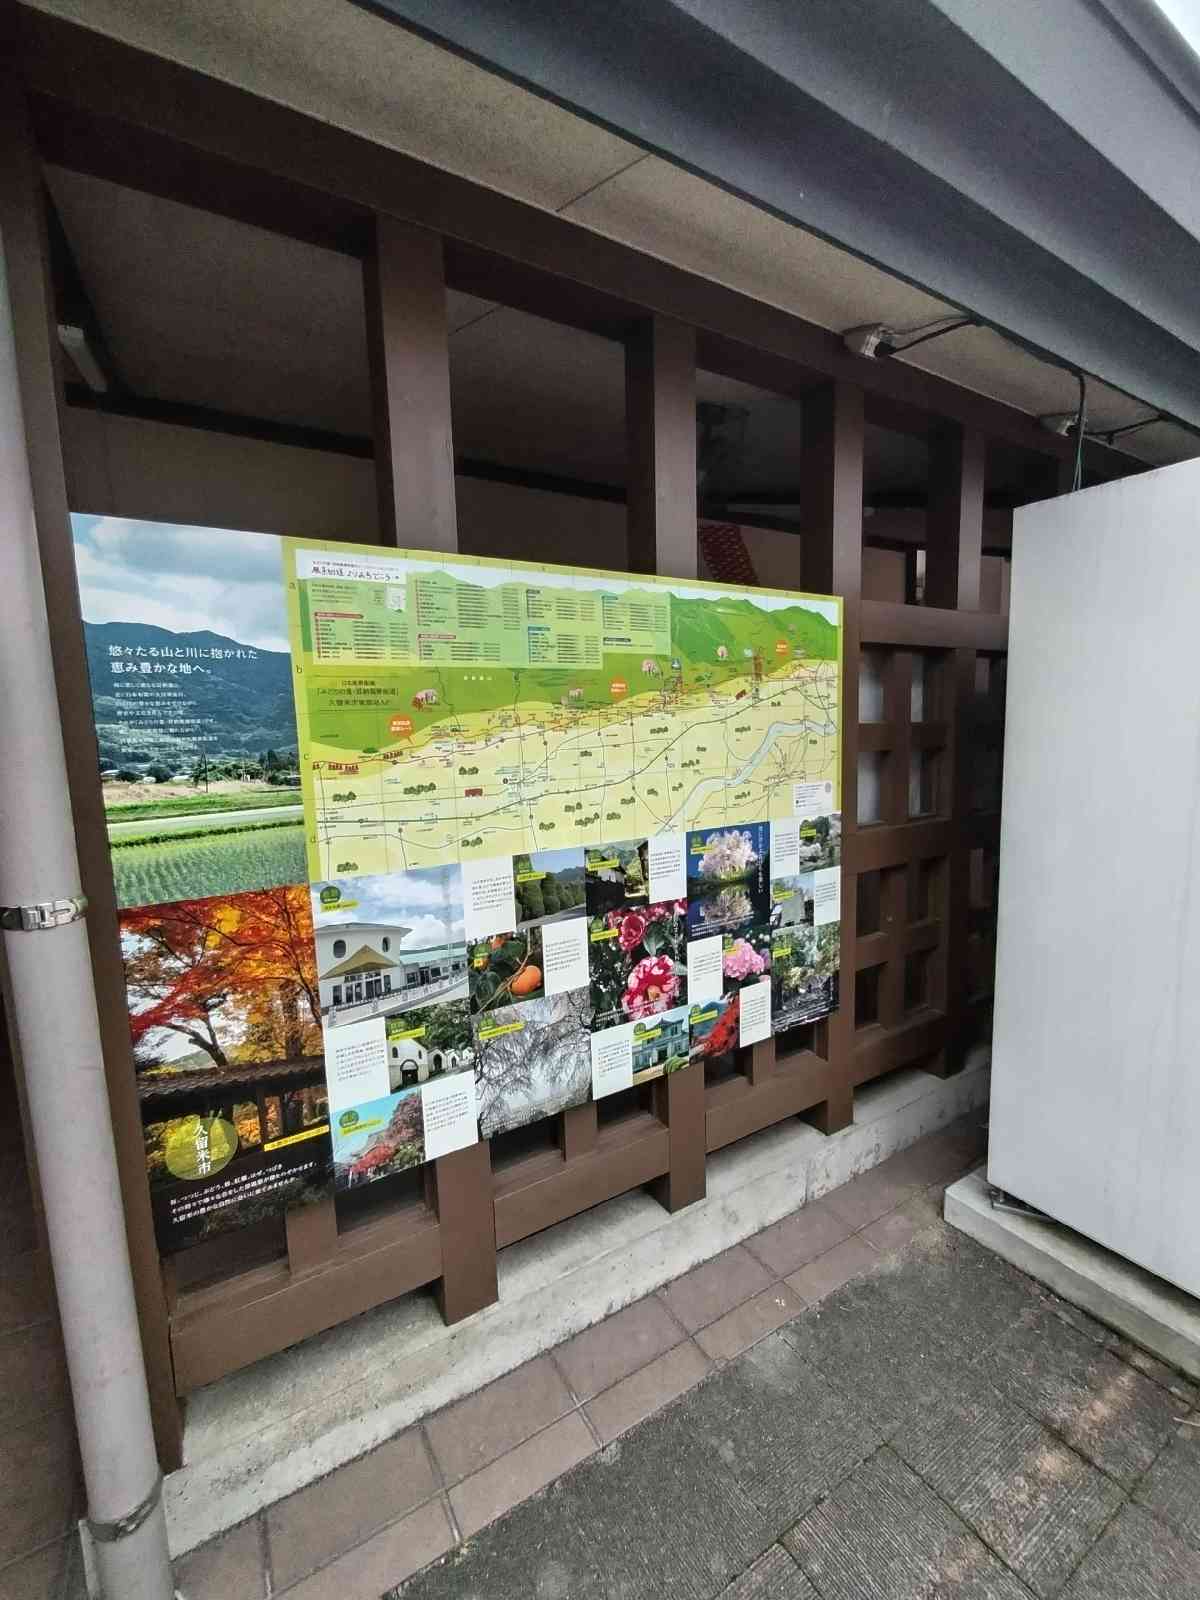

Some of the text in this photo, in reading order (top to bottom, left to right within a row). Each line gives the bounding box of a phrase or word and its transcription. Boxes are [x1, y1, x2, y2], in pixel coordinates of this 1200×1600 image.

[108, 644, 259, 660] 悠々たる山と川に抱かれた
[109, 661, 213, 675] 恵み豊かな地へ。
[193, 1123, 212, 1176] 久留米市
